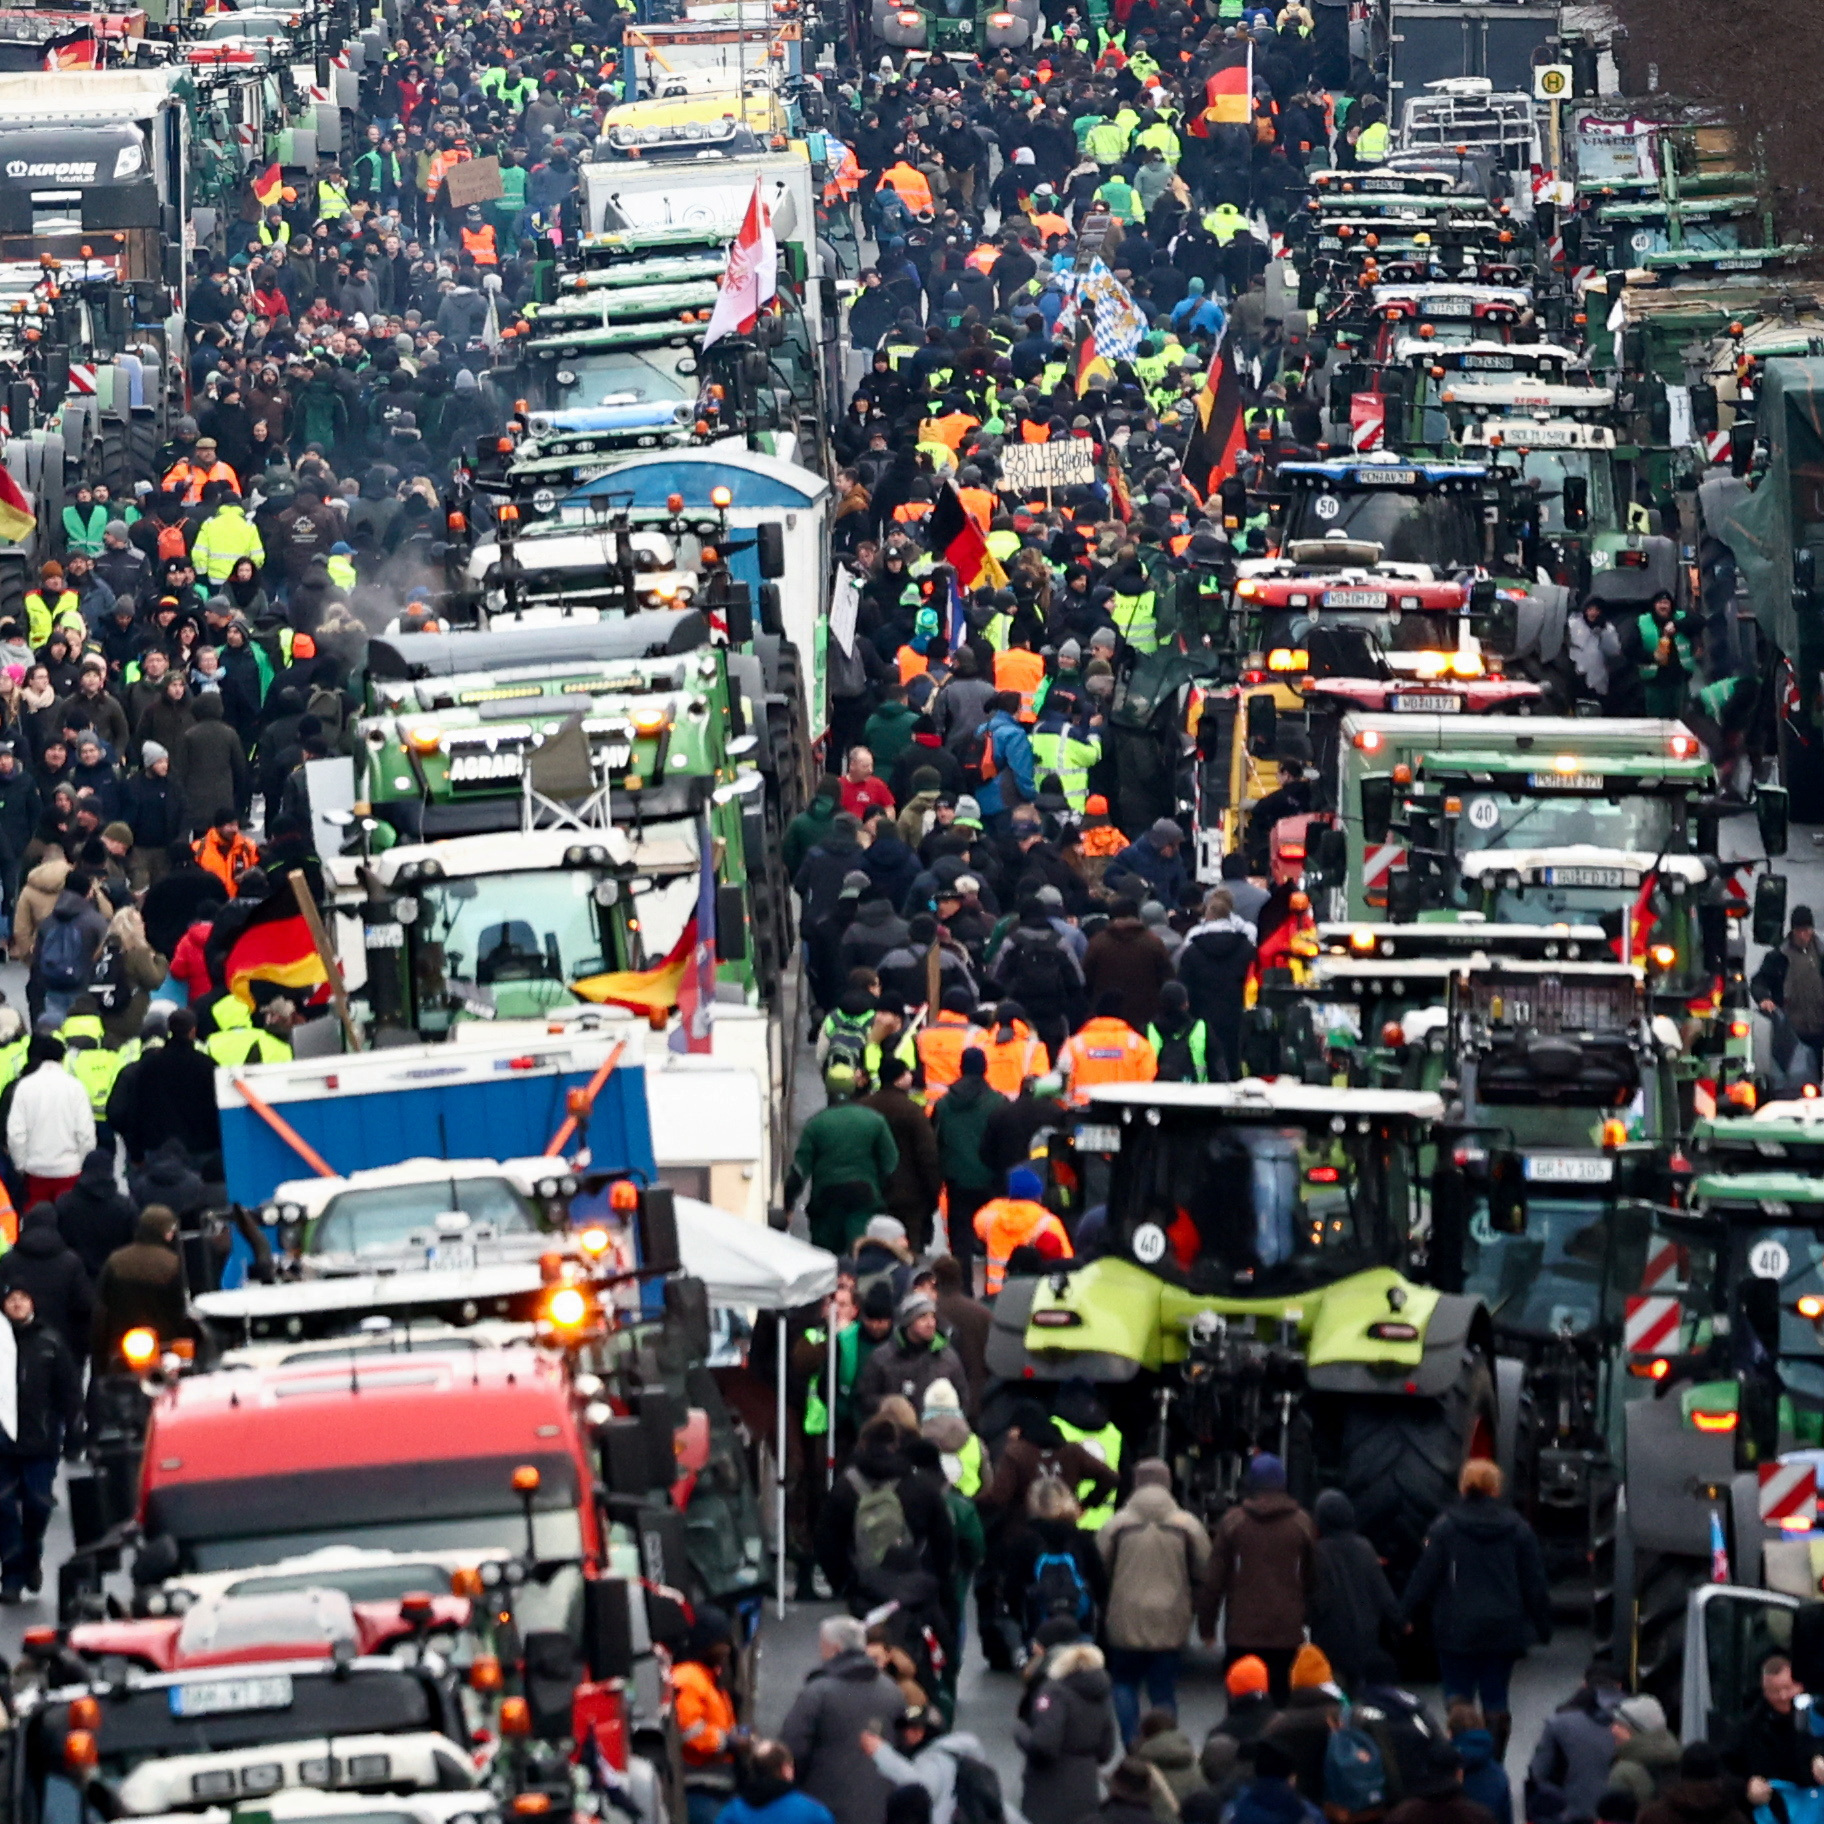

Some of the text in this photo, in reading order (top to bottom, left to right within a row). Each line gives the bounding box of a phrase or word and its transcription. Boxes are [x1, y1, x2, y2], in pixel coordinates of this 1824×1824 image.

[28, 161, 97, 176] KRONE
[1320, 499, 1335, 514] 50
[1475, 804, 1492, 823] 40
[1140, 1234, 1159, 1254] 40
[1759, 1250, 1781, 1271] 40
